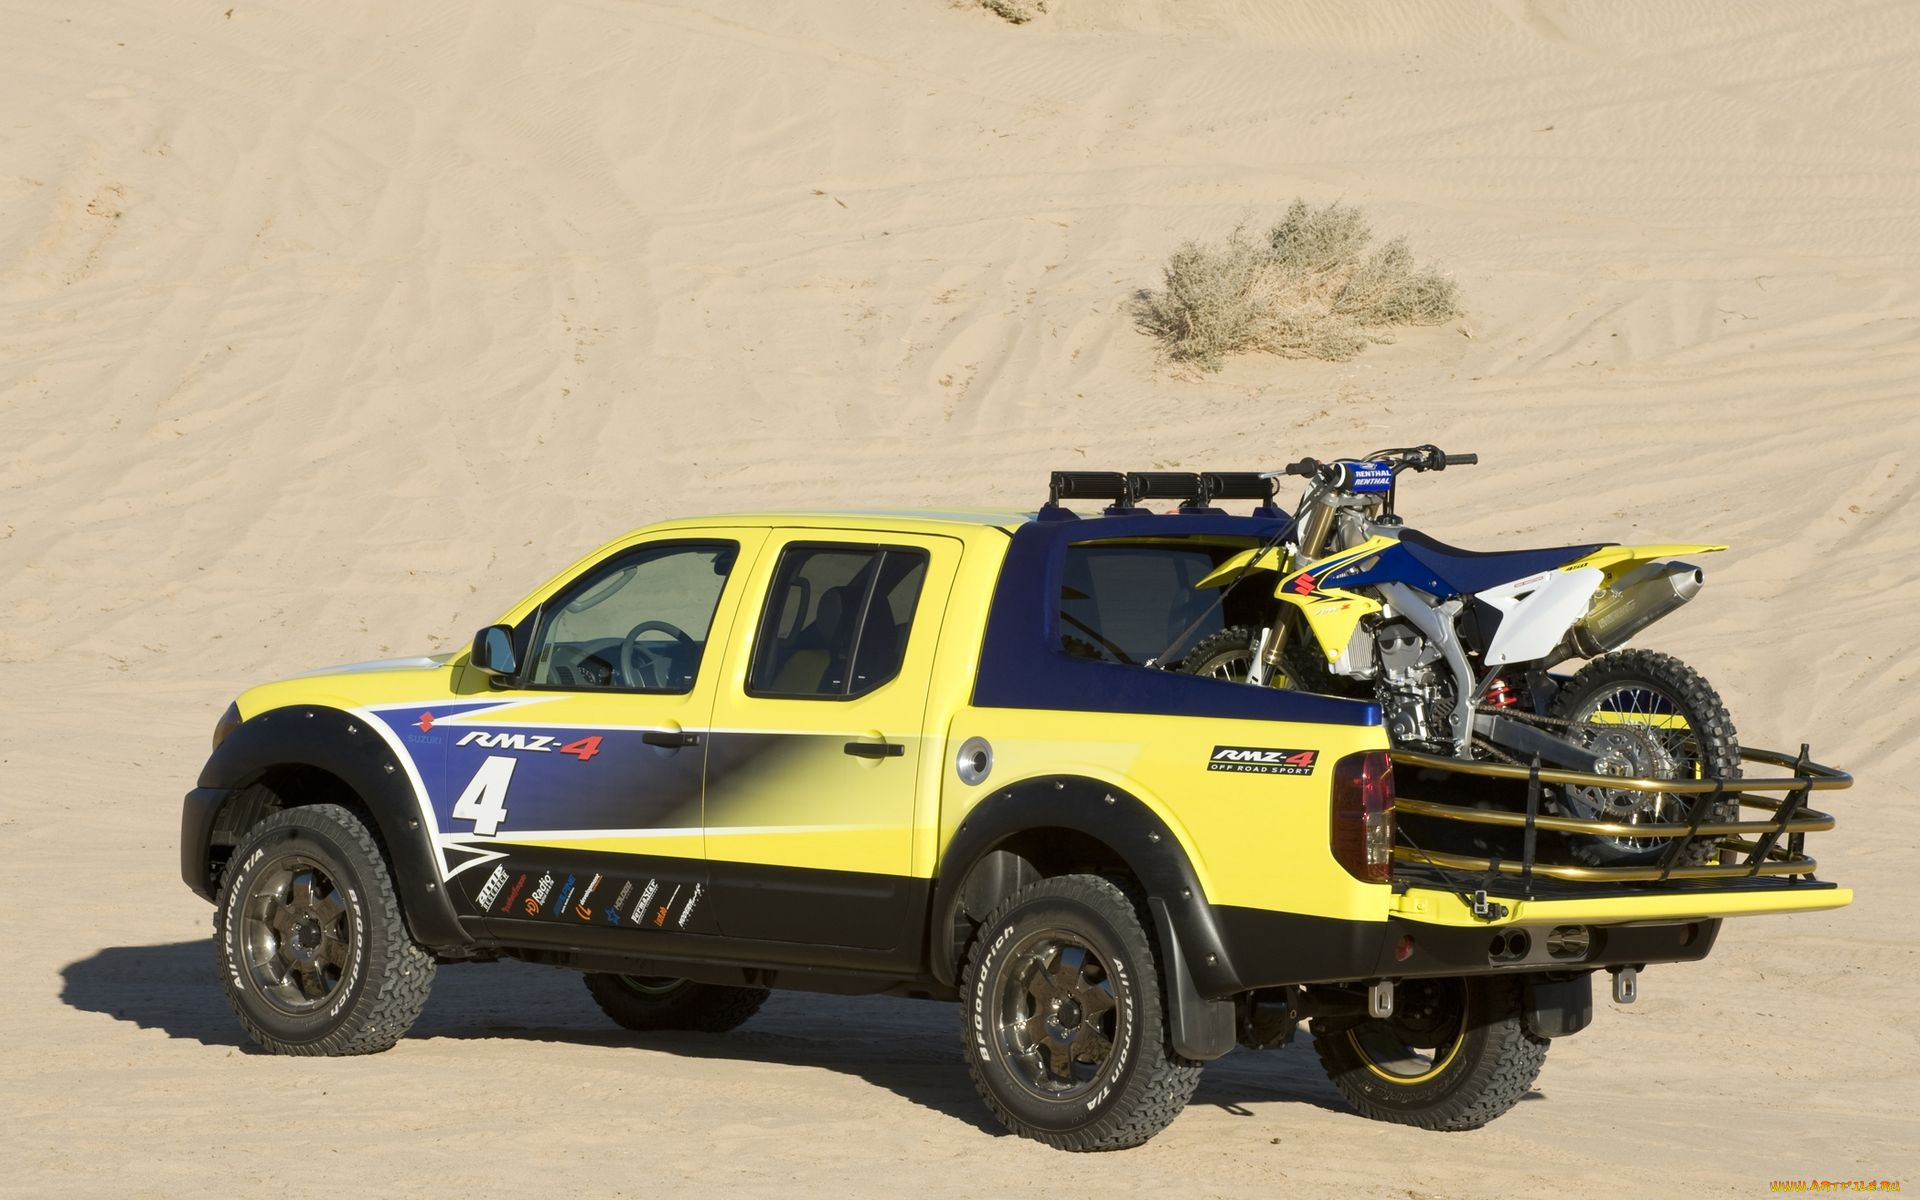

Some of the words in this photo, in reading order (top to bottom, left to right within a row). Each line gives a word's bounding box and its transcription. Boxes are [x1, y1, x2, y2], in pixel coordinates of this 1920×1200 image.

[456, 731, 603, 761] RMZ-4
[1213, 749, 1315, 767] RMZ-4
[452, 755, 518, 837] 4
[226, 877, 245, 990] All-Terrain
[243, 848, 264, 872] T/A
[532, 872, 552, 902] Radio
[330, 889, 364, 1017] BFGoodrich
[975, 925, 1014, 1062] BFGoodrich
[1112, 958, 1133, 1083] All-Terrain
[1086, 1087, 1110, 1111] T/A
